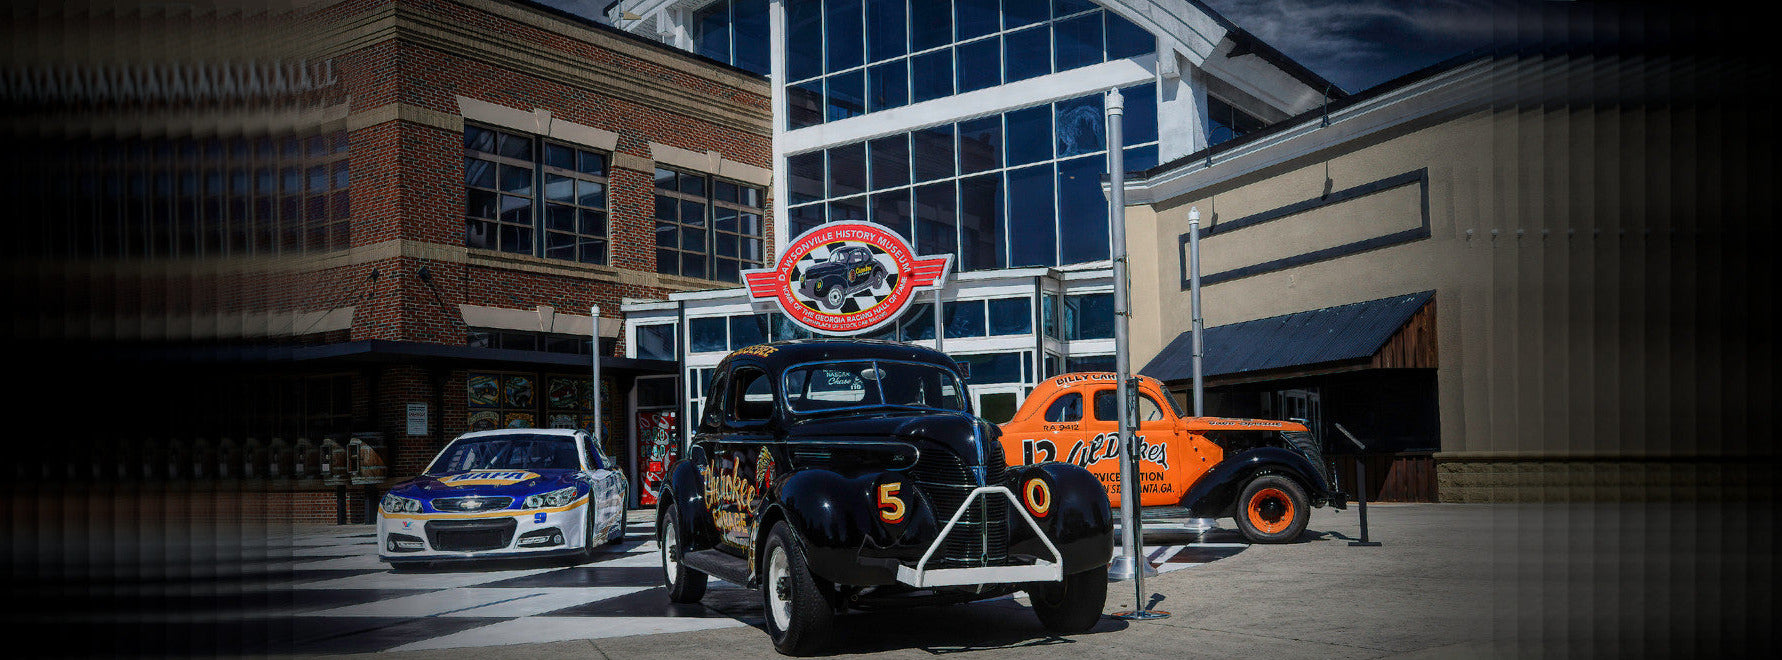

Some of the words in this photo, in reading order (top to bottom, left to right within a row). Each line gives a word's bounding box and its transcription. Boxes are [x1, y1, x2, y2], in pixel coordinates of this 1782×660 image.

[778, 232, 833, 281] DAWSONVILLE
[835, 229, 877, 241] HISTORY
[877, 236, 911, 273] MUSEUM
[782, 284, 795, 304] HOME
[793, 302, 803, 311] OF
[803, 308, 815, 318] THE
[814, 313, 846, 323] GEORGIA
[846, 311, 873, 321] RACING
[872, 302, 890, 315] HALL
[888, 293, 898, 304] OF
[896, 276, 908, 295] FAME
[1056, 374, 1089, 387] BILLY
[1022, 439, 1057, 466] 12
[1102, 432, 1169, 471] Dkes
[448, 471, 525, 482] NAPA
[877, 482, 906, 524] 5
[1023, 477, 1051, 518] 0
[534, 512, 547, 524] 9
